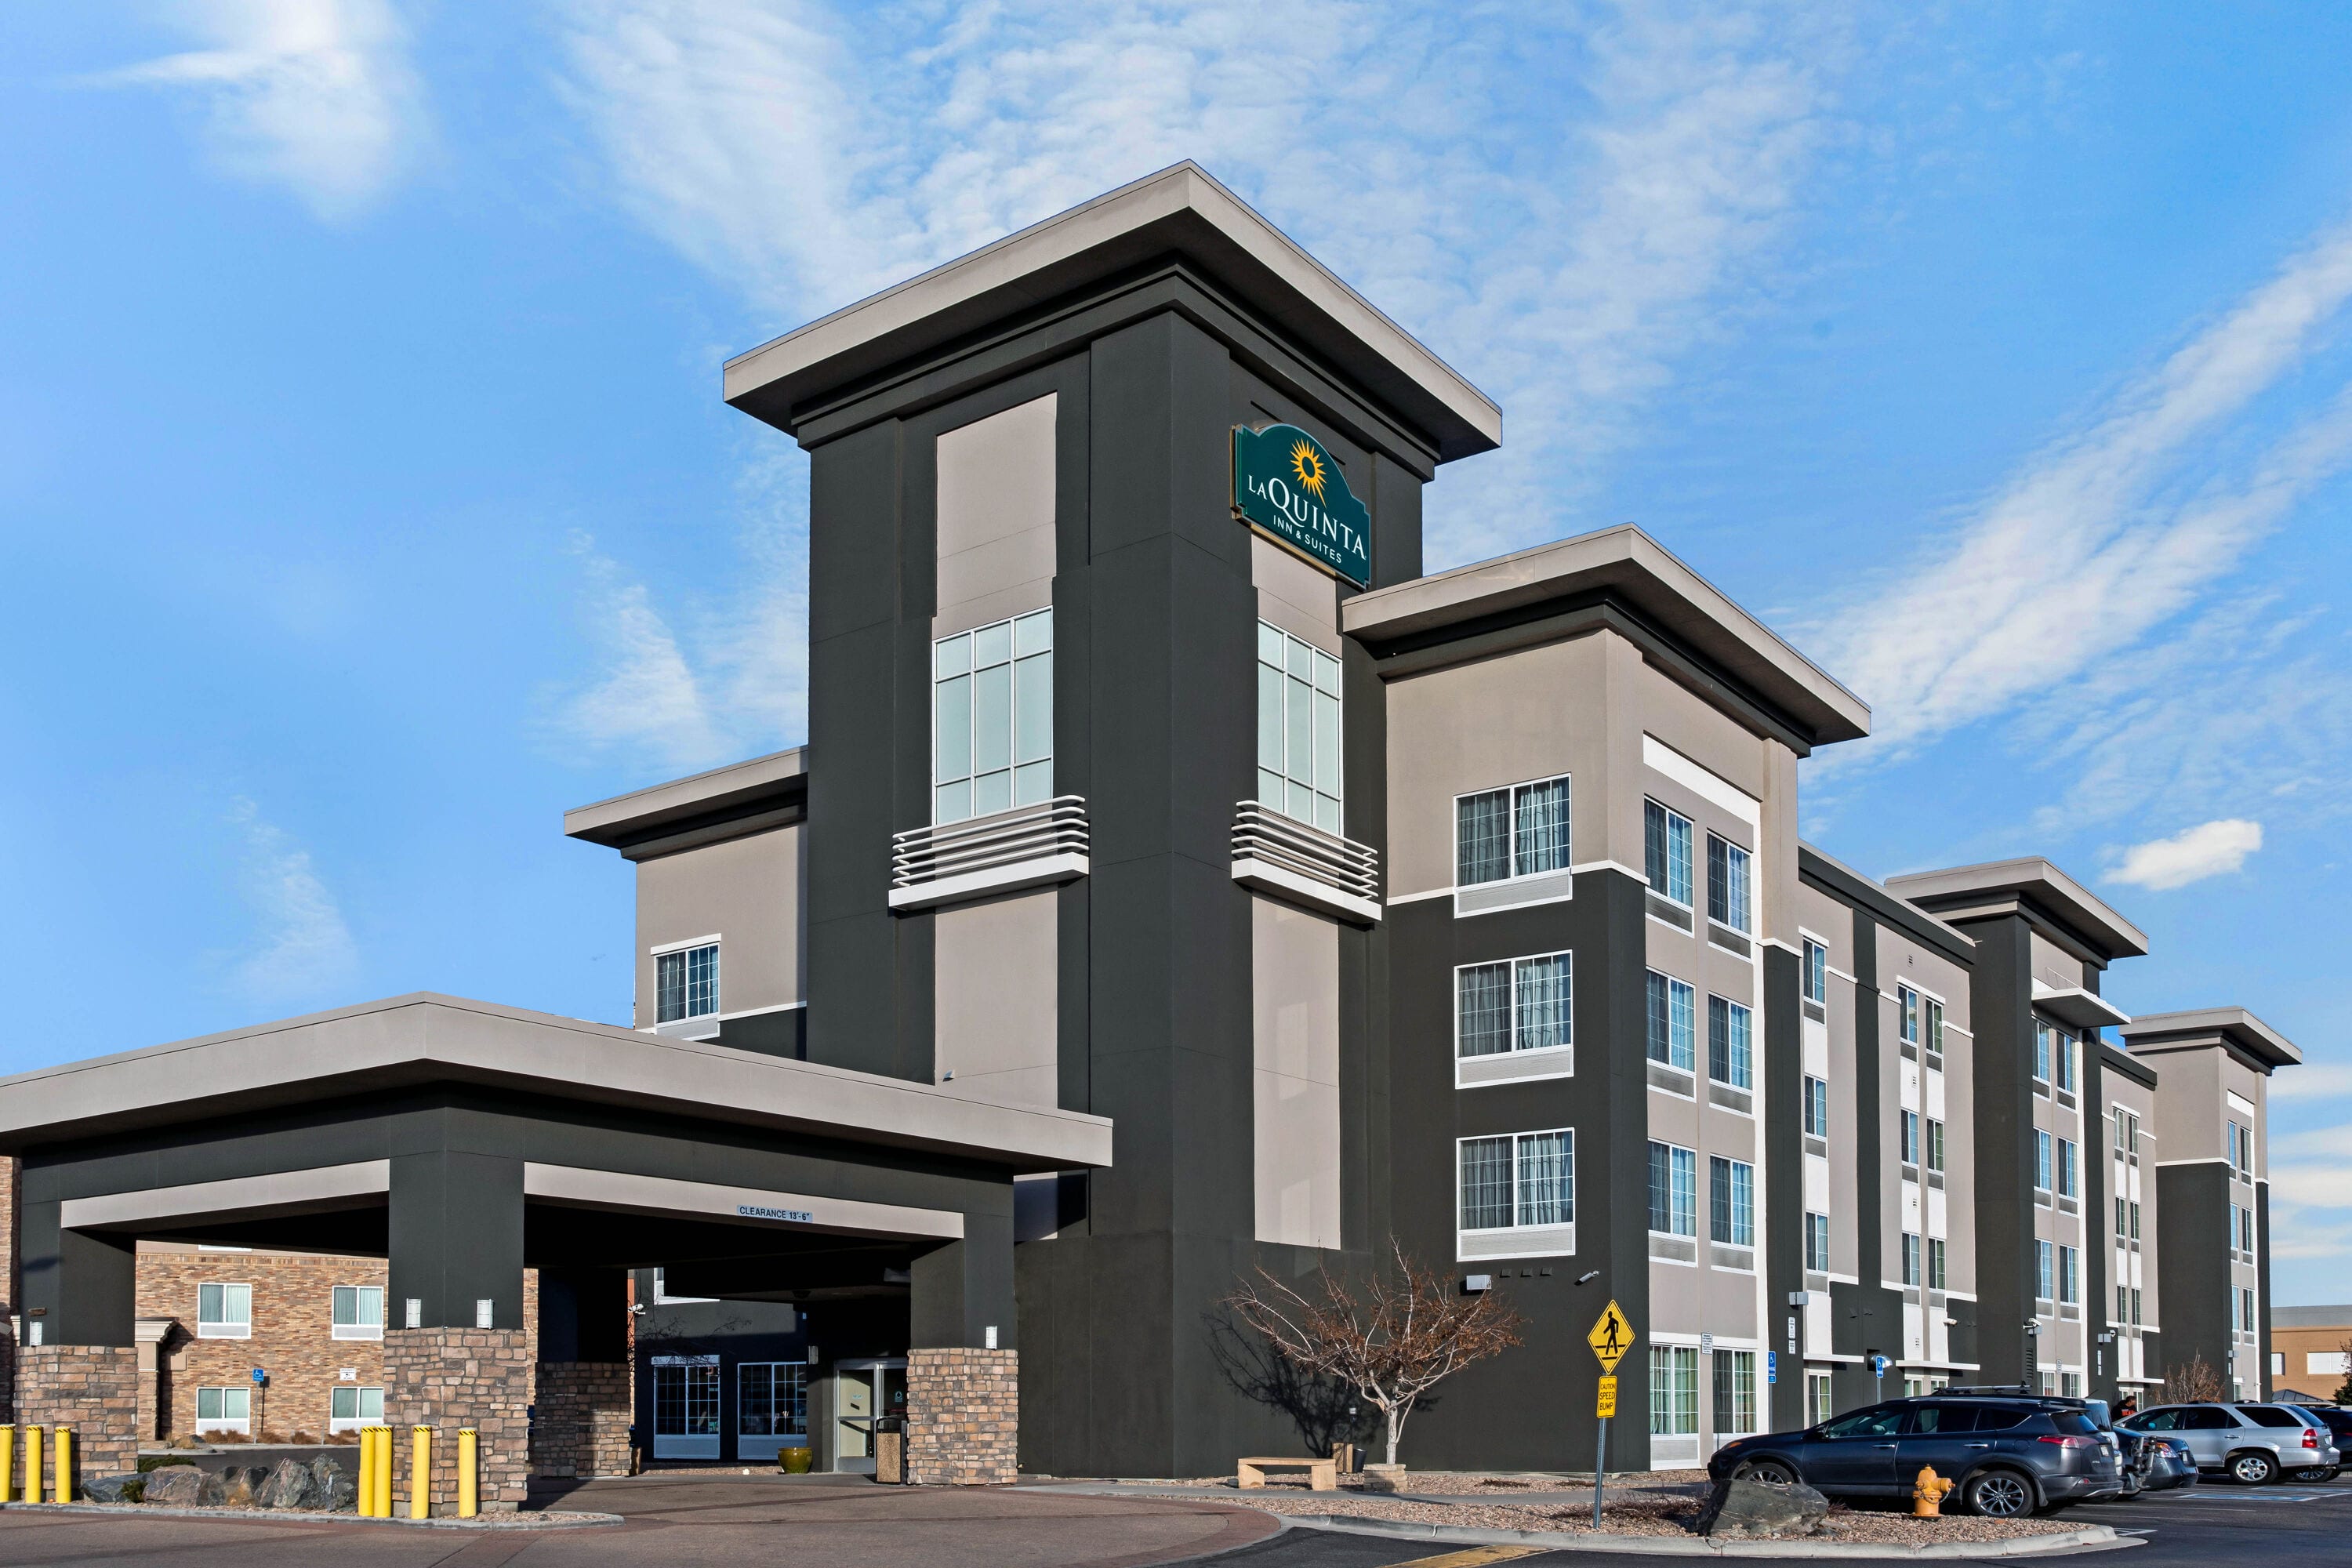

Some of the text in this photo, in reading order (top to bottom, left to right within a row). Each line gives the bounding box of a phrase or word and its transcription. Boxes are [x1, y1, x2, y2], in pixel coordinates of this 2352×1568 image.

[1273, 514, 1342, 564] INN & SUITES
[739, 1206, 786, 1218] CLEARANCE
